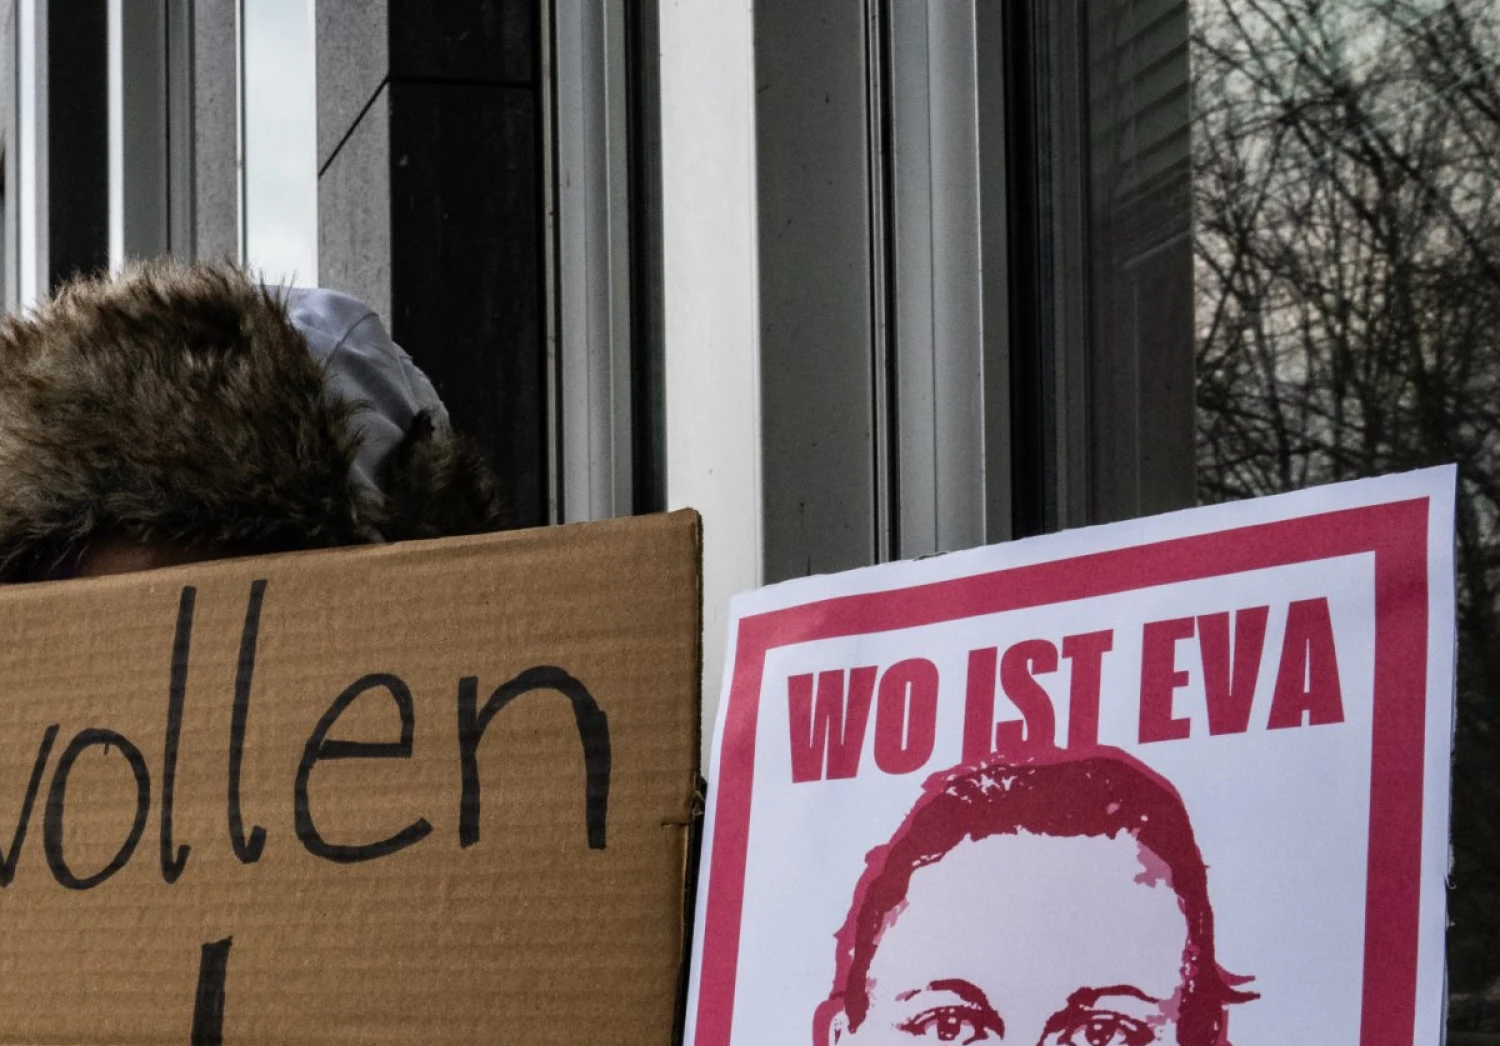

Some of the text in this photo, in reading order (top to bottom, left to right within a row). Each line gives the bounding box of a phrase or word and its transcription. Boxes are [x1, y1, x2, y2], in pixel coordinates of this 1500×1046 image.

[786, 596, 1345, 784] WO IST EVA
